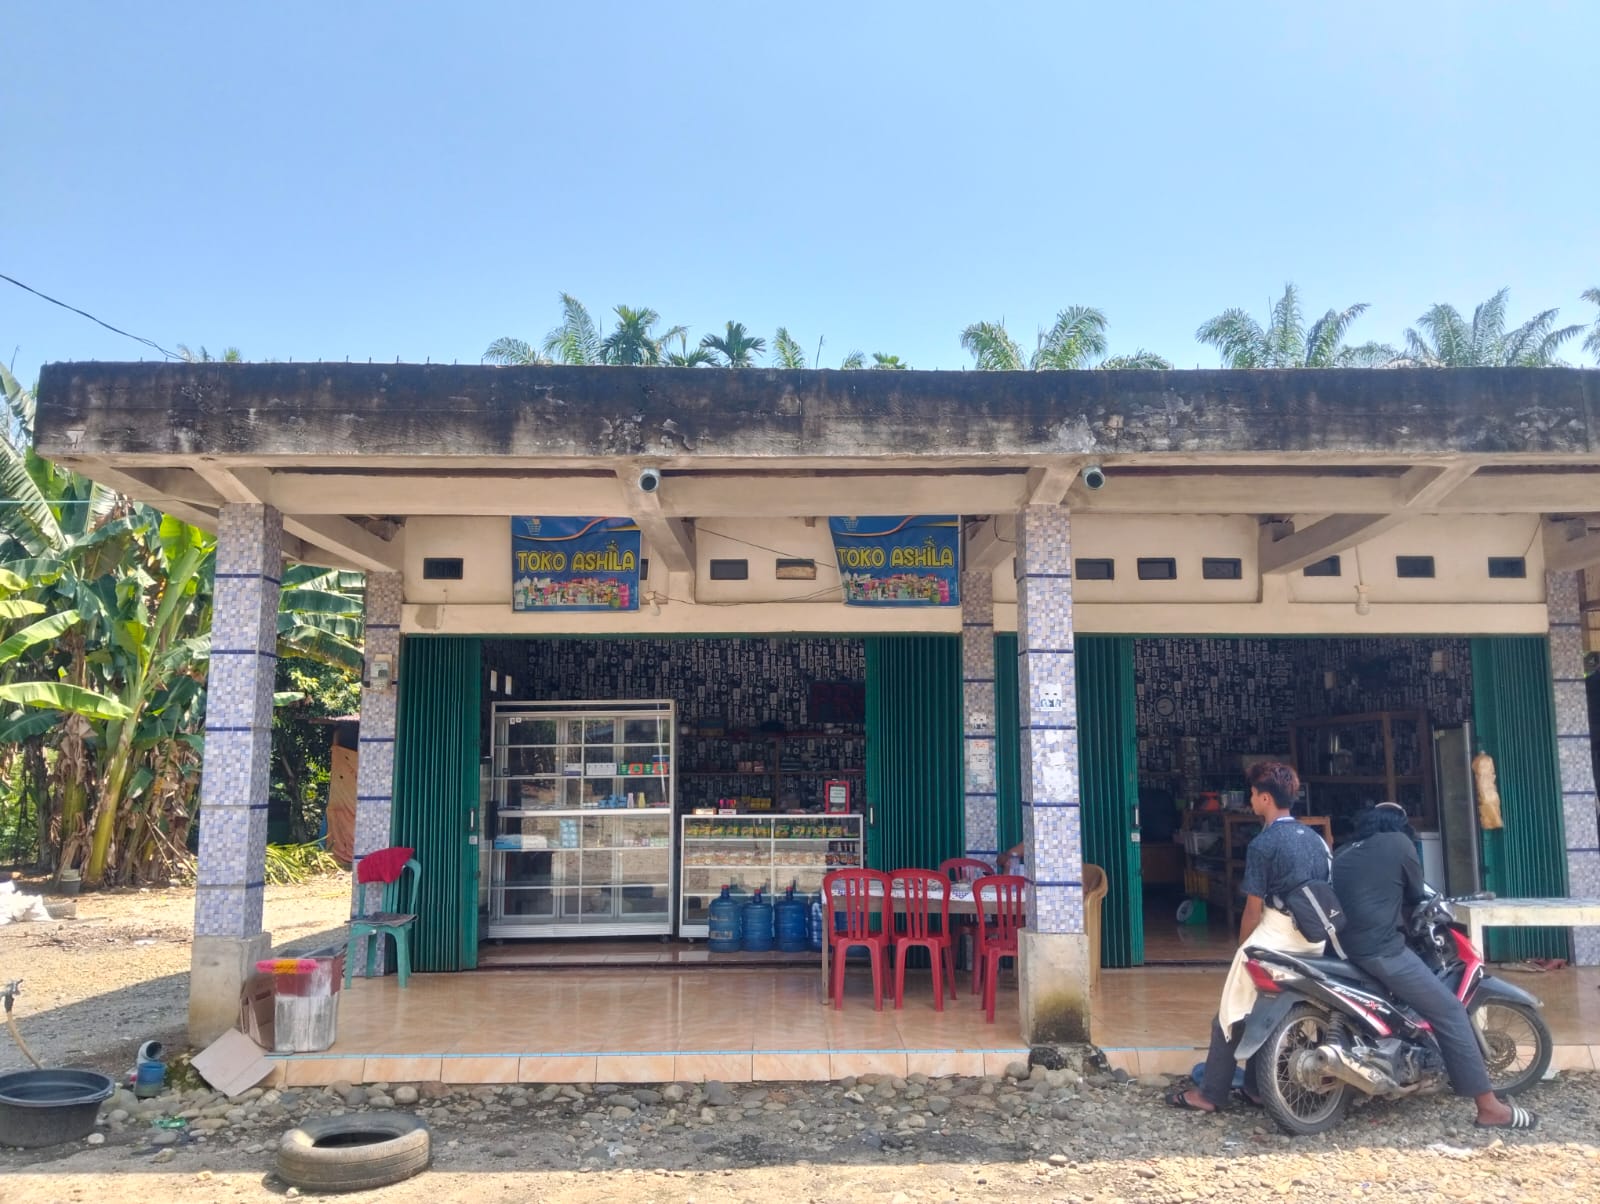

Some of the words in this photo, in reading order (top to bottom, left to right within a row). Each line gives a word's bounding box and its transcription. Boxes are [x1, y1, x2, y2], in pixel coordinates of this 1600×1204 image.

[517, 551, 566, 573] TOKO
[571, 549, 636, 573] ASHILA
[838, 546, 885, 568] TOKO
[890, 545, 954, 568] ASHILA
